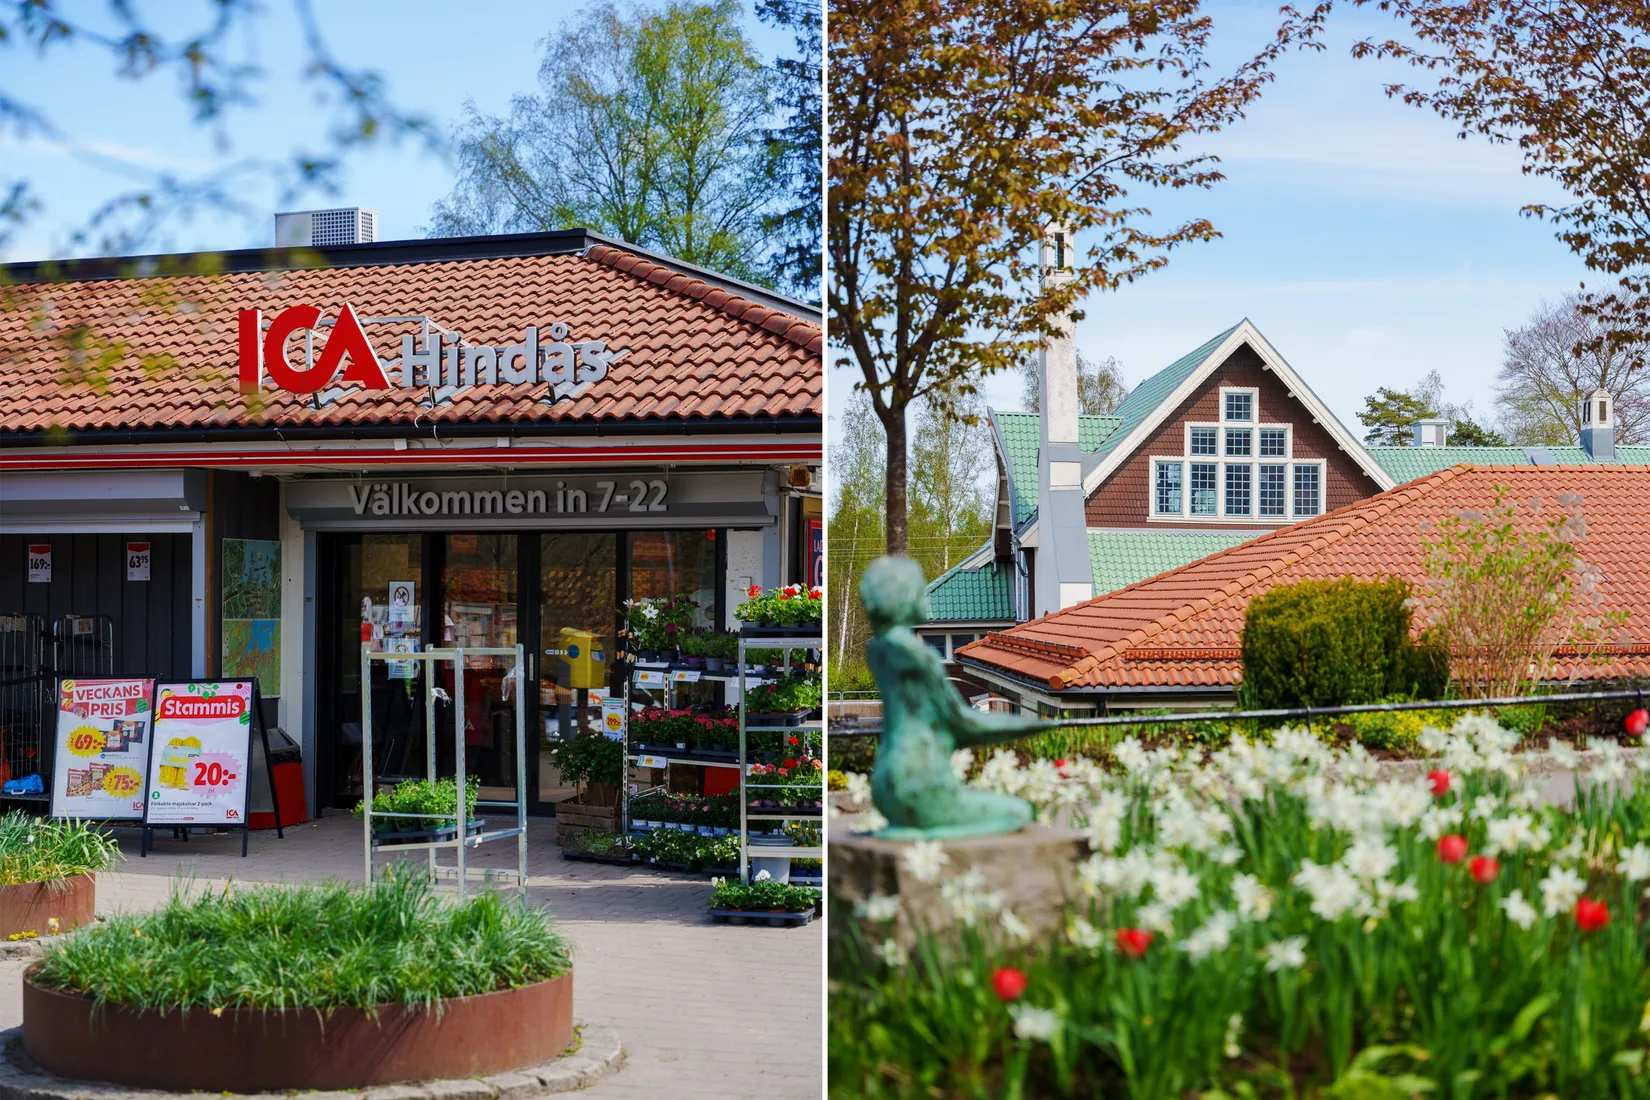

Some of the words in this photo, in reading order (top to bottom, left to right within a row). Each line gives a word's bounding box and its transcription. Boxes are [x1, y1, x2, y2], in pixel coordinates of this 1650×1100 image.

[238, 301, 393, 395] ICA
[402, 321, 609, 388] Hindås
[347, 482, 547, 516] Välkommen
[556, 480, 589, 513] in
[596, 479, 669, 513] 7-22
[75, 685, 141, 700] VECKANS
[90, 703, 123, 716] PRIS
[164, 698, 240, 715] Stammis
[74, 734, 102, 750] 69:-
[113, 774, 139, 790] 75:-
[194, 762, 237, 786] 20:-
[226, 809, 239, 817] ICA
